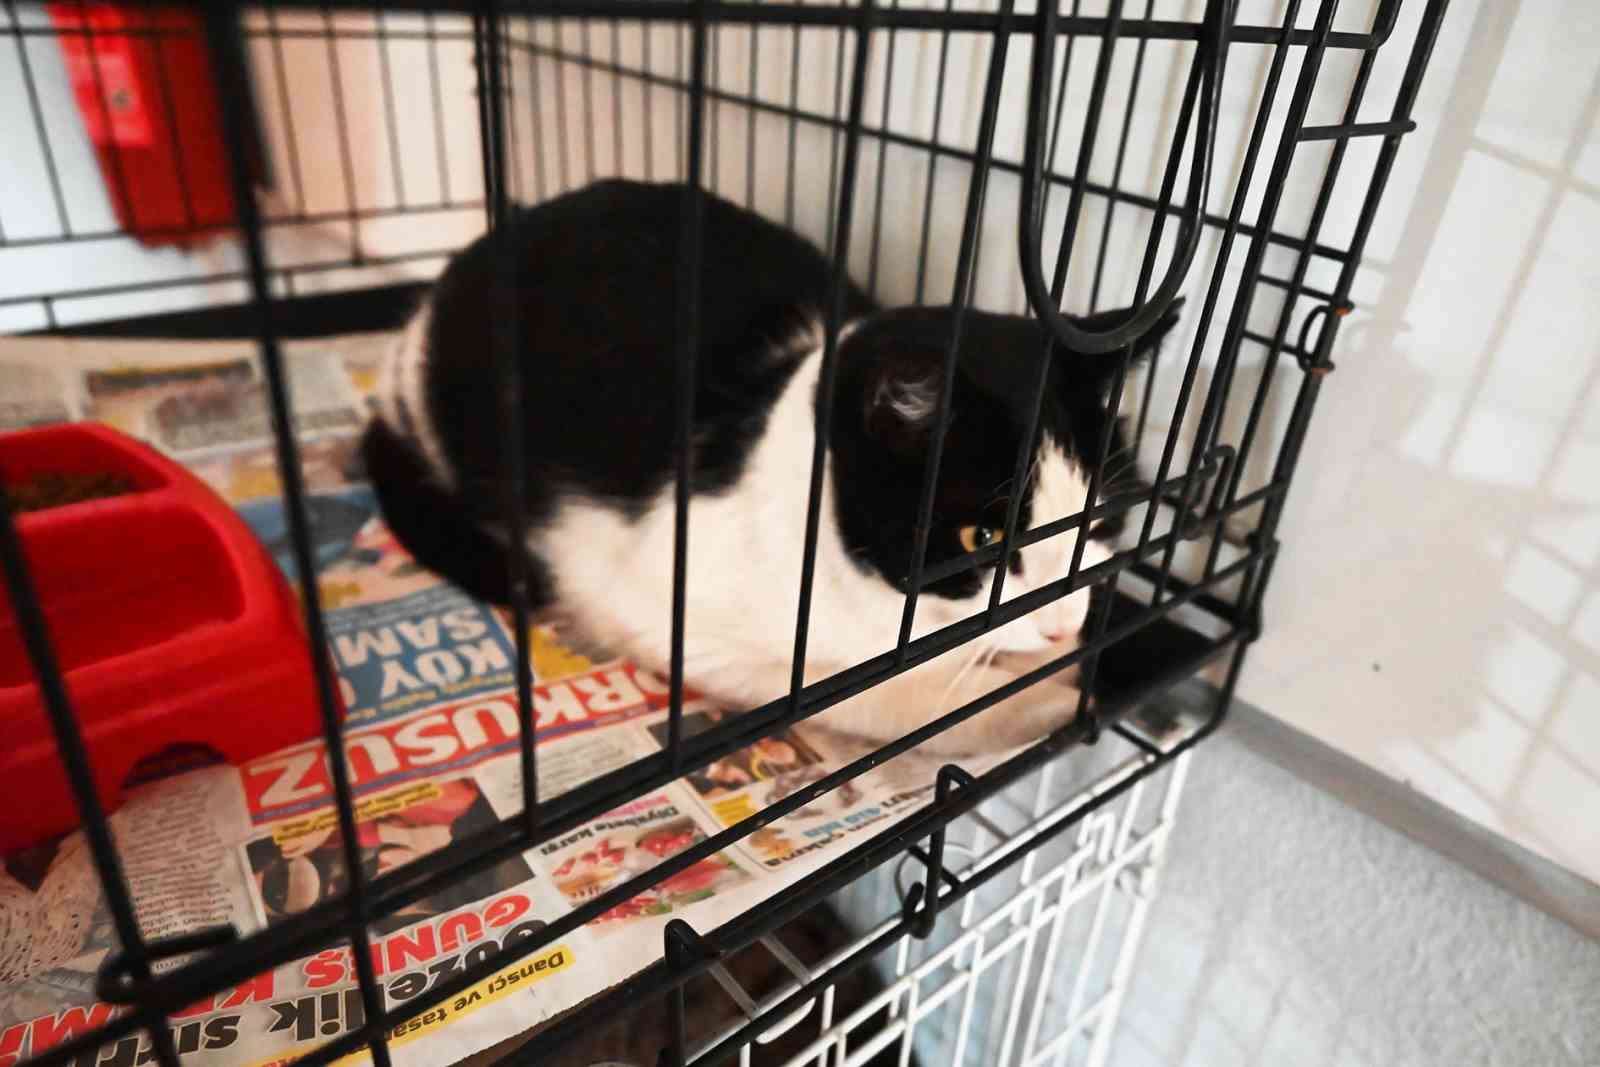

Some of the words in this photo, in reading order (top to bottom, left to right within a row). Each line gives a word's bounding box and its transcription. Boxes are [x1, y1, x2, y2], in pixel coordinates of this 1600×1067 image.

[304, 894, 532, 988] GÜNEŞ
[488, 951, 564, 995] Dansçı
[454, 989, 482, 1011] ve
